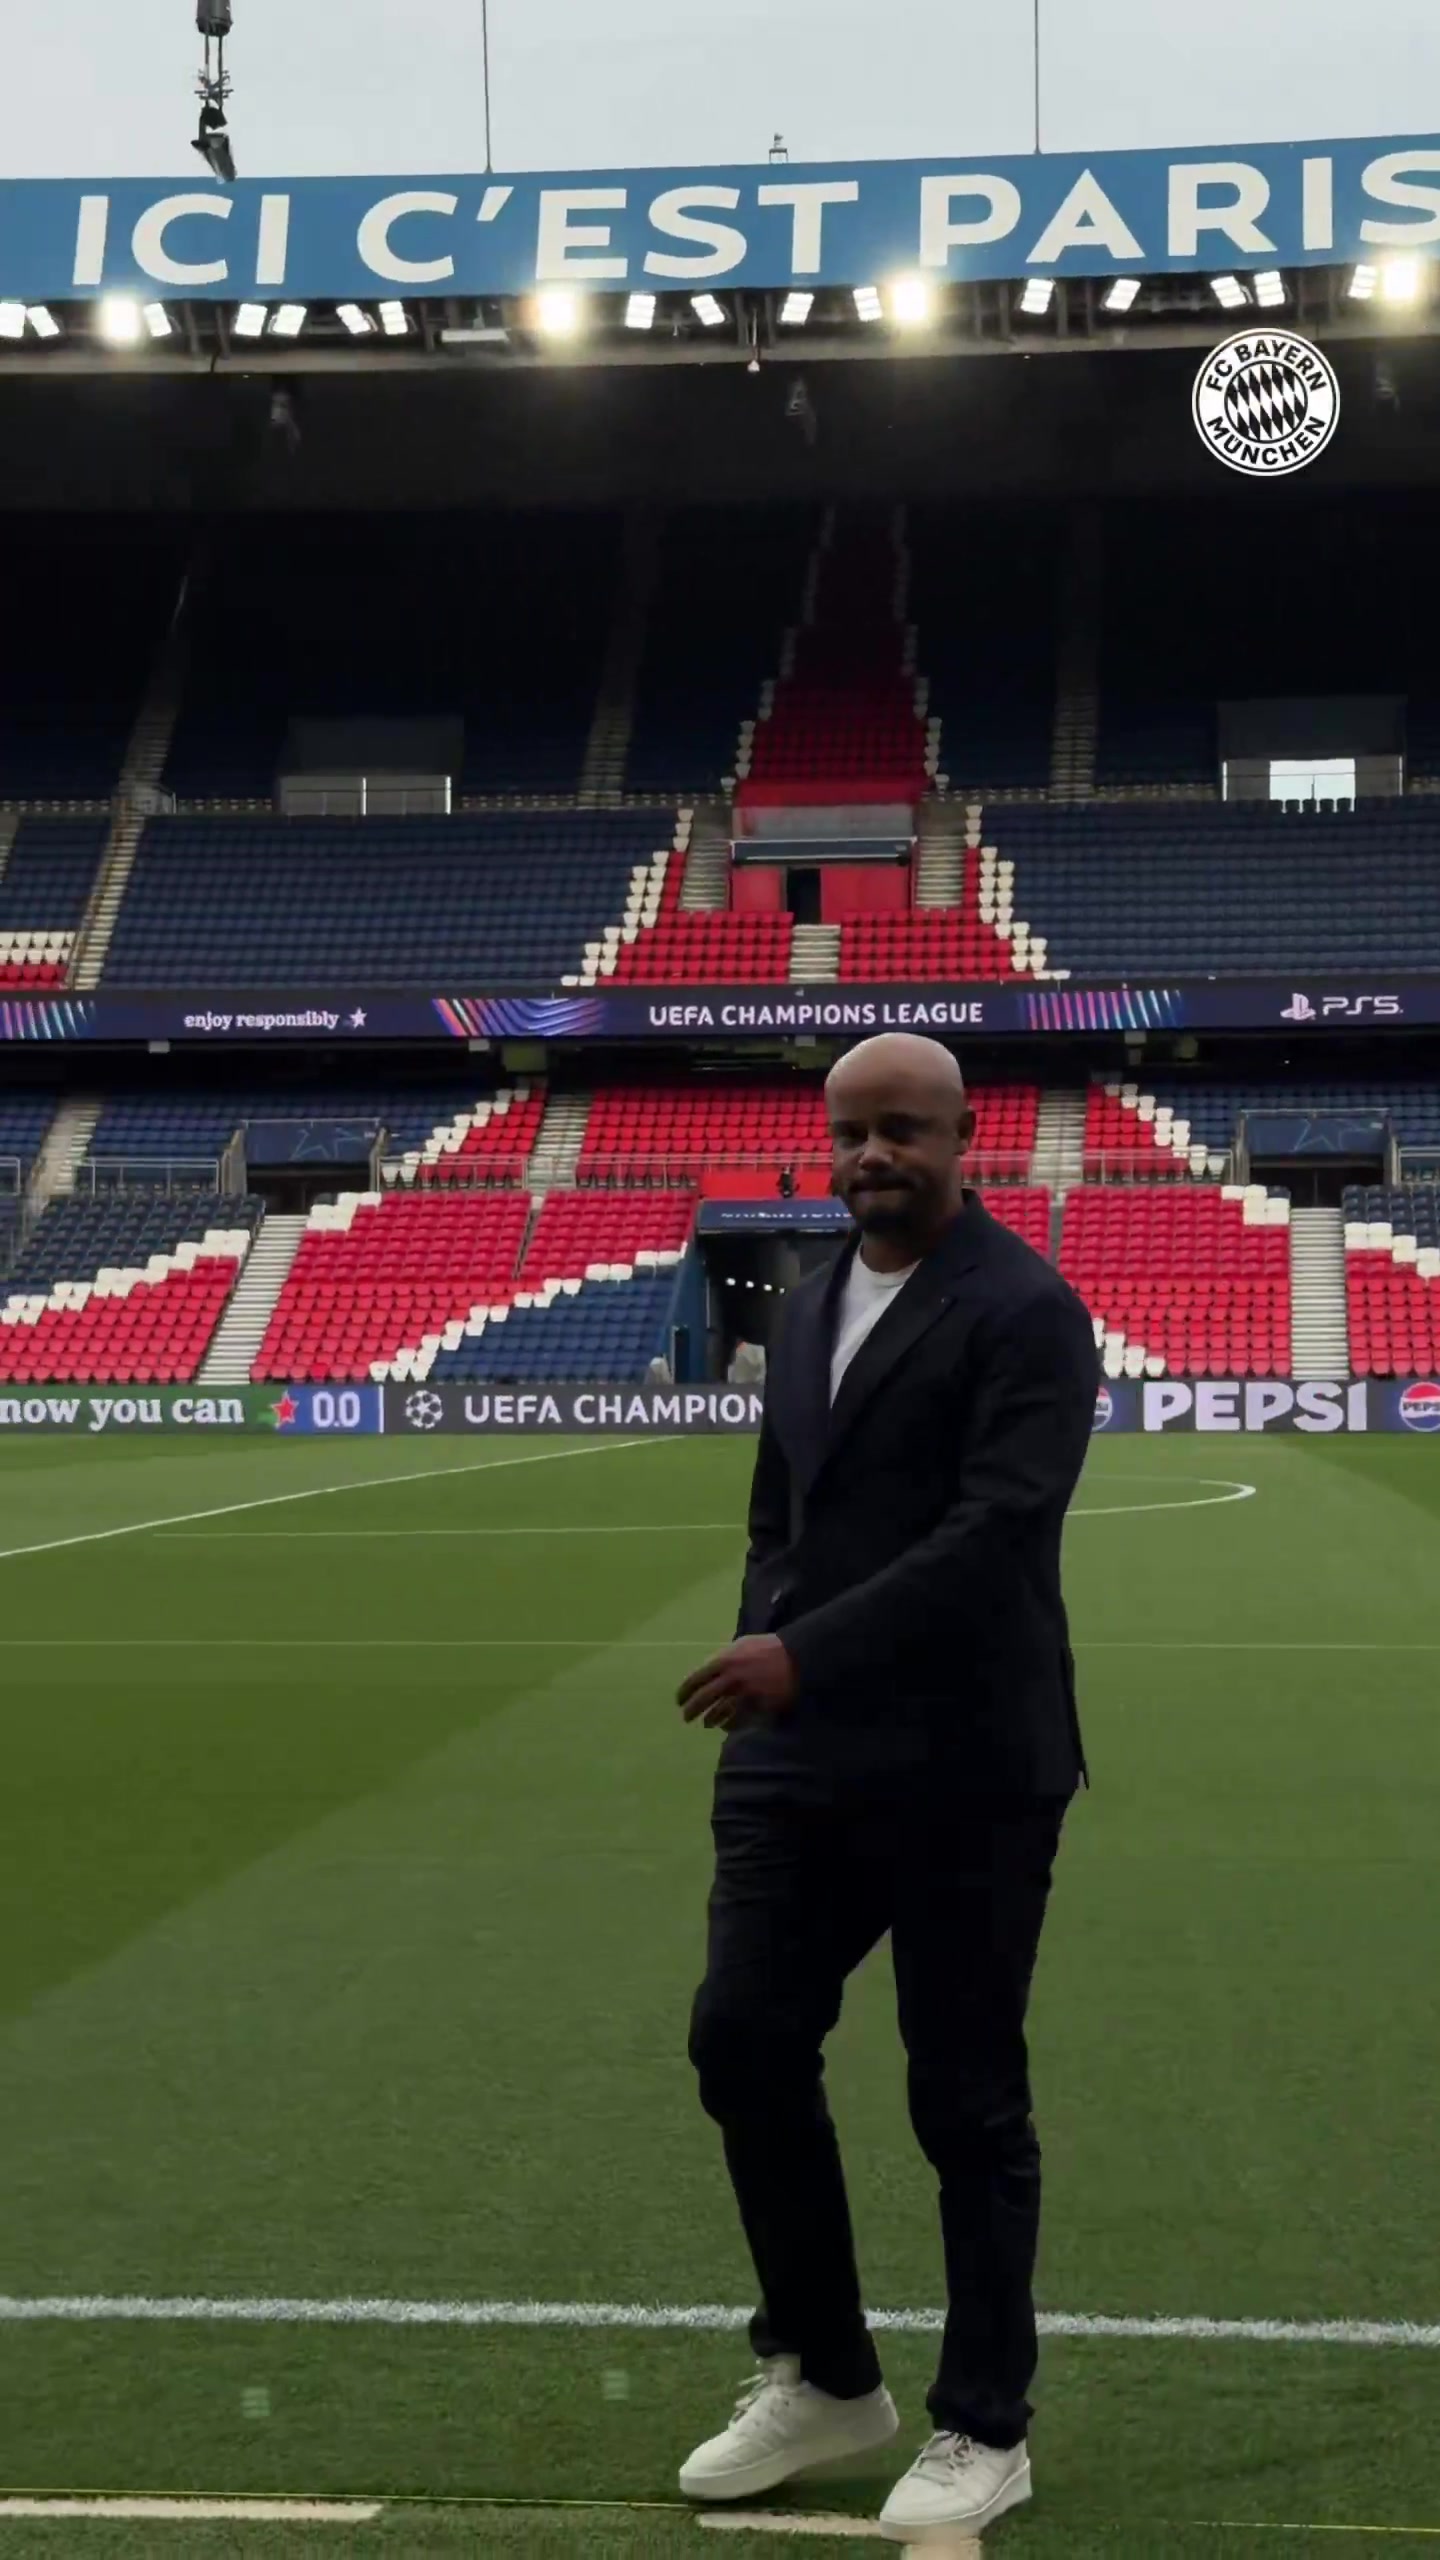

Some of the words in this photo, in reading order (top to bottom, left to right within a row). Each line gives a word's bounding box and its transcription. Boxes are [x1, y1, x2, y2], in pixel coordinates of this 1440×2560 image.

[72, 193, 290, 286] ICI
[357, 180, 859, 283] C'EST
[919, 150, 1440, 267] PARIS
[184, 1011, 232, 1031] enjoy
[236, 1009, 339, 1030] responsibly
[649, 1005, 714, 1026] UEFA
[721, 1004, 876, 1025] CHAMPIONS
[883, 1003, 983, 1024] LEAGUE
[89, 1398, 162, 1431] you
[172, 1398, 244, 1423] can
[312, 1392, 361, 1428] 0.0
[464, 1394, 562, 1424] UEFA
[1143, 1382, 1367, 1432] PEPSI
